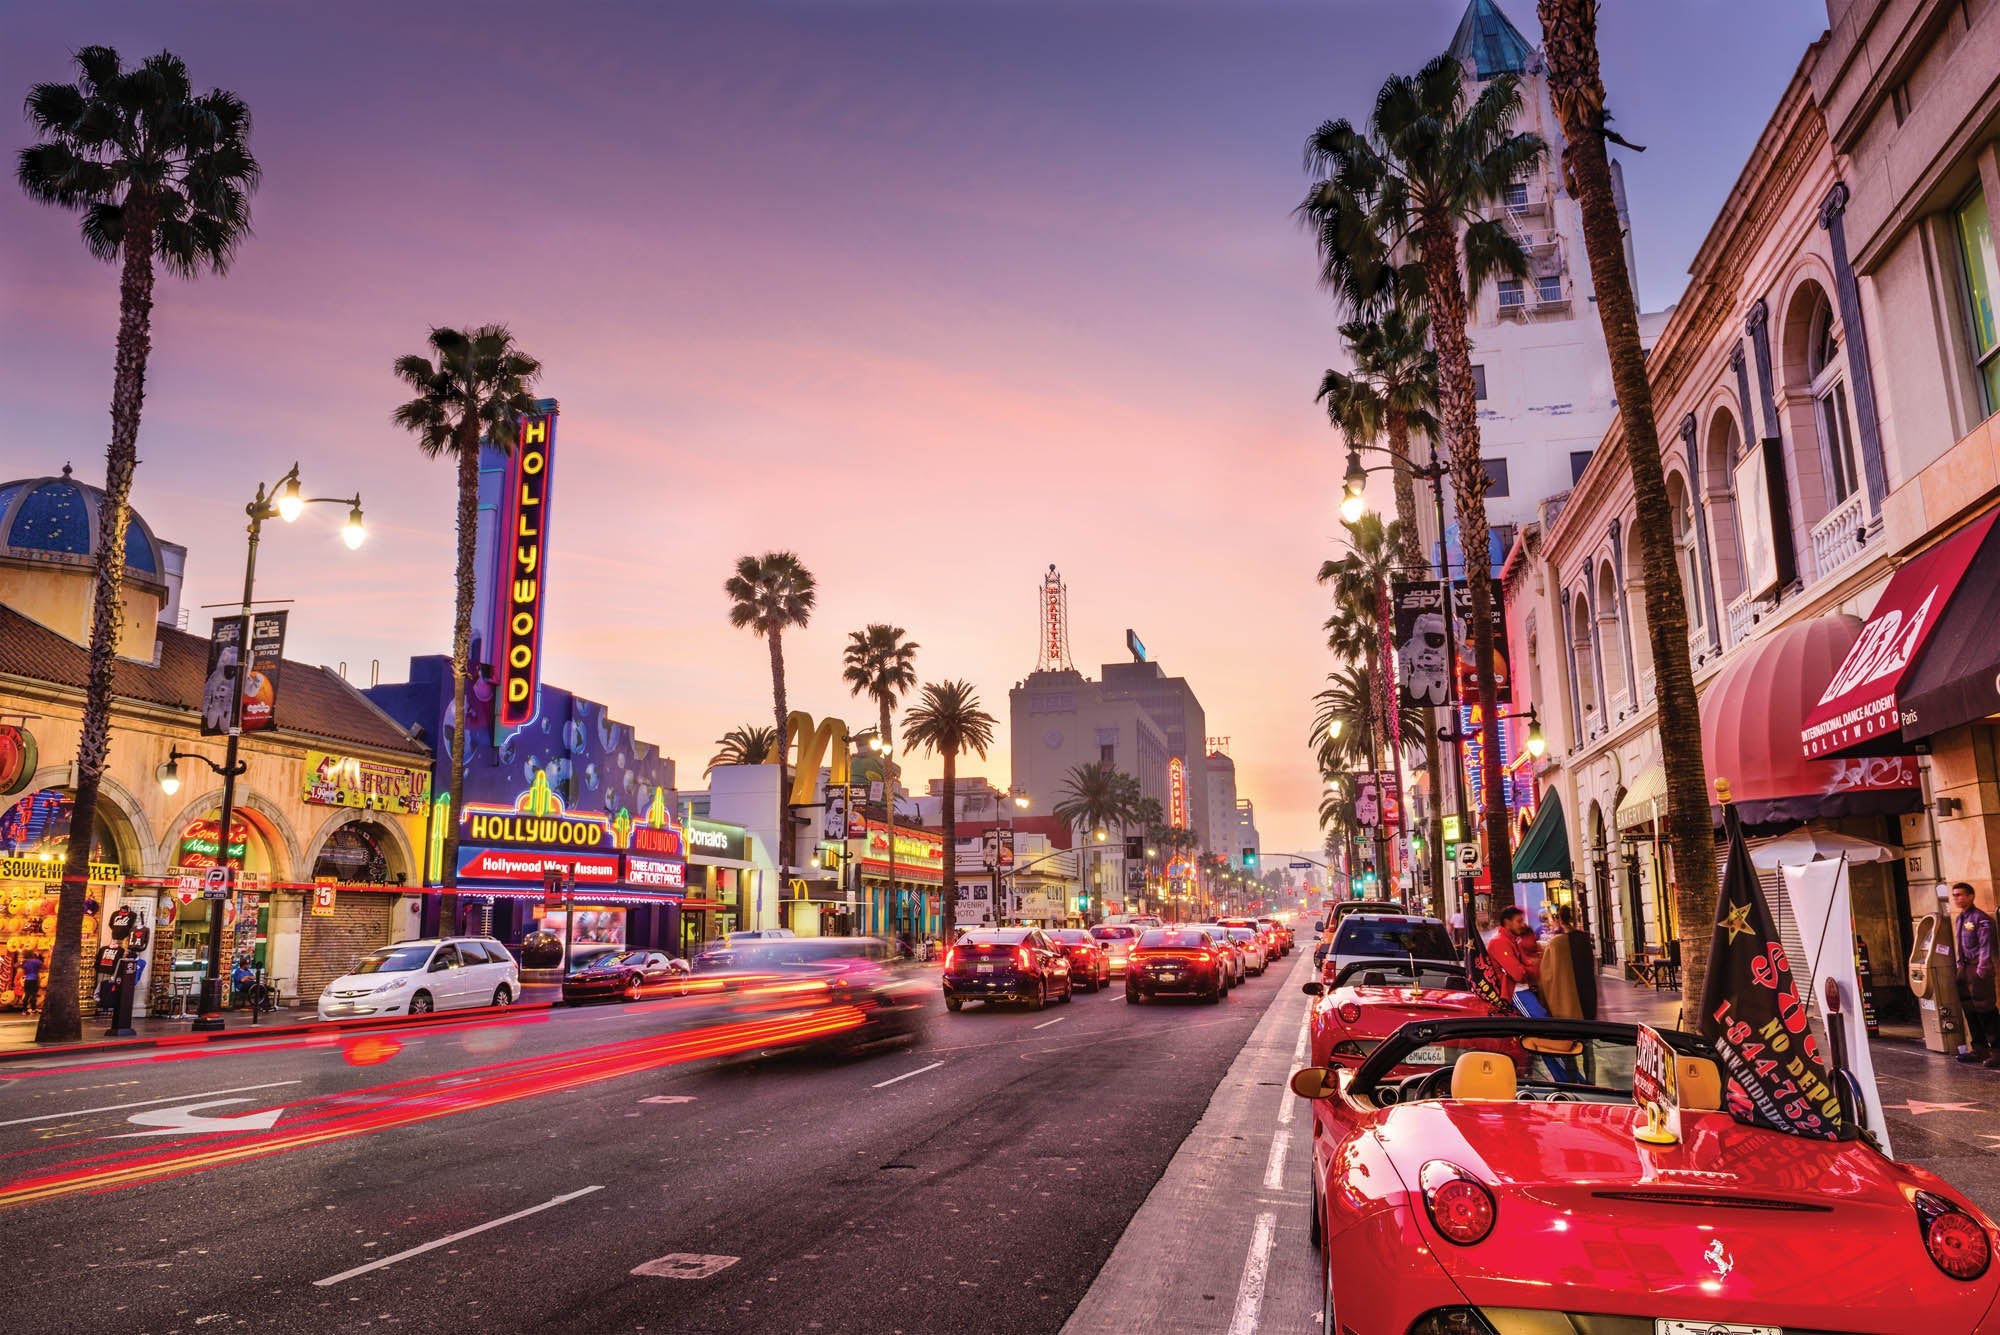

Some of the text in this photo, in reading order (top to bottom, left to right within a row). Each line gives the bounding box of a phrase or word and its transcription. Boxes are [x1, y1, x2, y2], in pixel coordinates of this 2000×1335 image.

[509, 421, 545, 702] HOLLYWOOD
[1801, 693, 1895, 742] INTERNATIONAL DANCE ACADEMY
[1901, 709, 1918, 727] Paris
[1803, 710, 1899, 756] HOLLYWOOD
[472, 815, 601, 845] HOLLYWOOD
[636, 829, 678, 853] HOLLYWOOD
[3, 860, 64, 880] SOUVENI
[482, 858, 542, 874] Hollywood
[543, 860, 568, 874] Wax
[630, 859, 682, 875] THREE ATTRACTIONS
[1538, 871, 1561, 879] GALORE
[180, 878, 198, 889] ATM
[629, 871, 642, 882] ONE
[641, 873, 662, 884] TICKET
[316, 887, 332, 906] $5
[1758, 1017, 1790, 1053] NO
